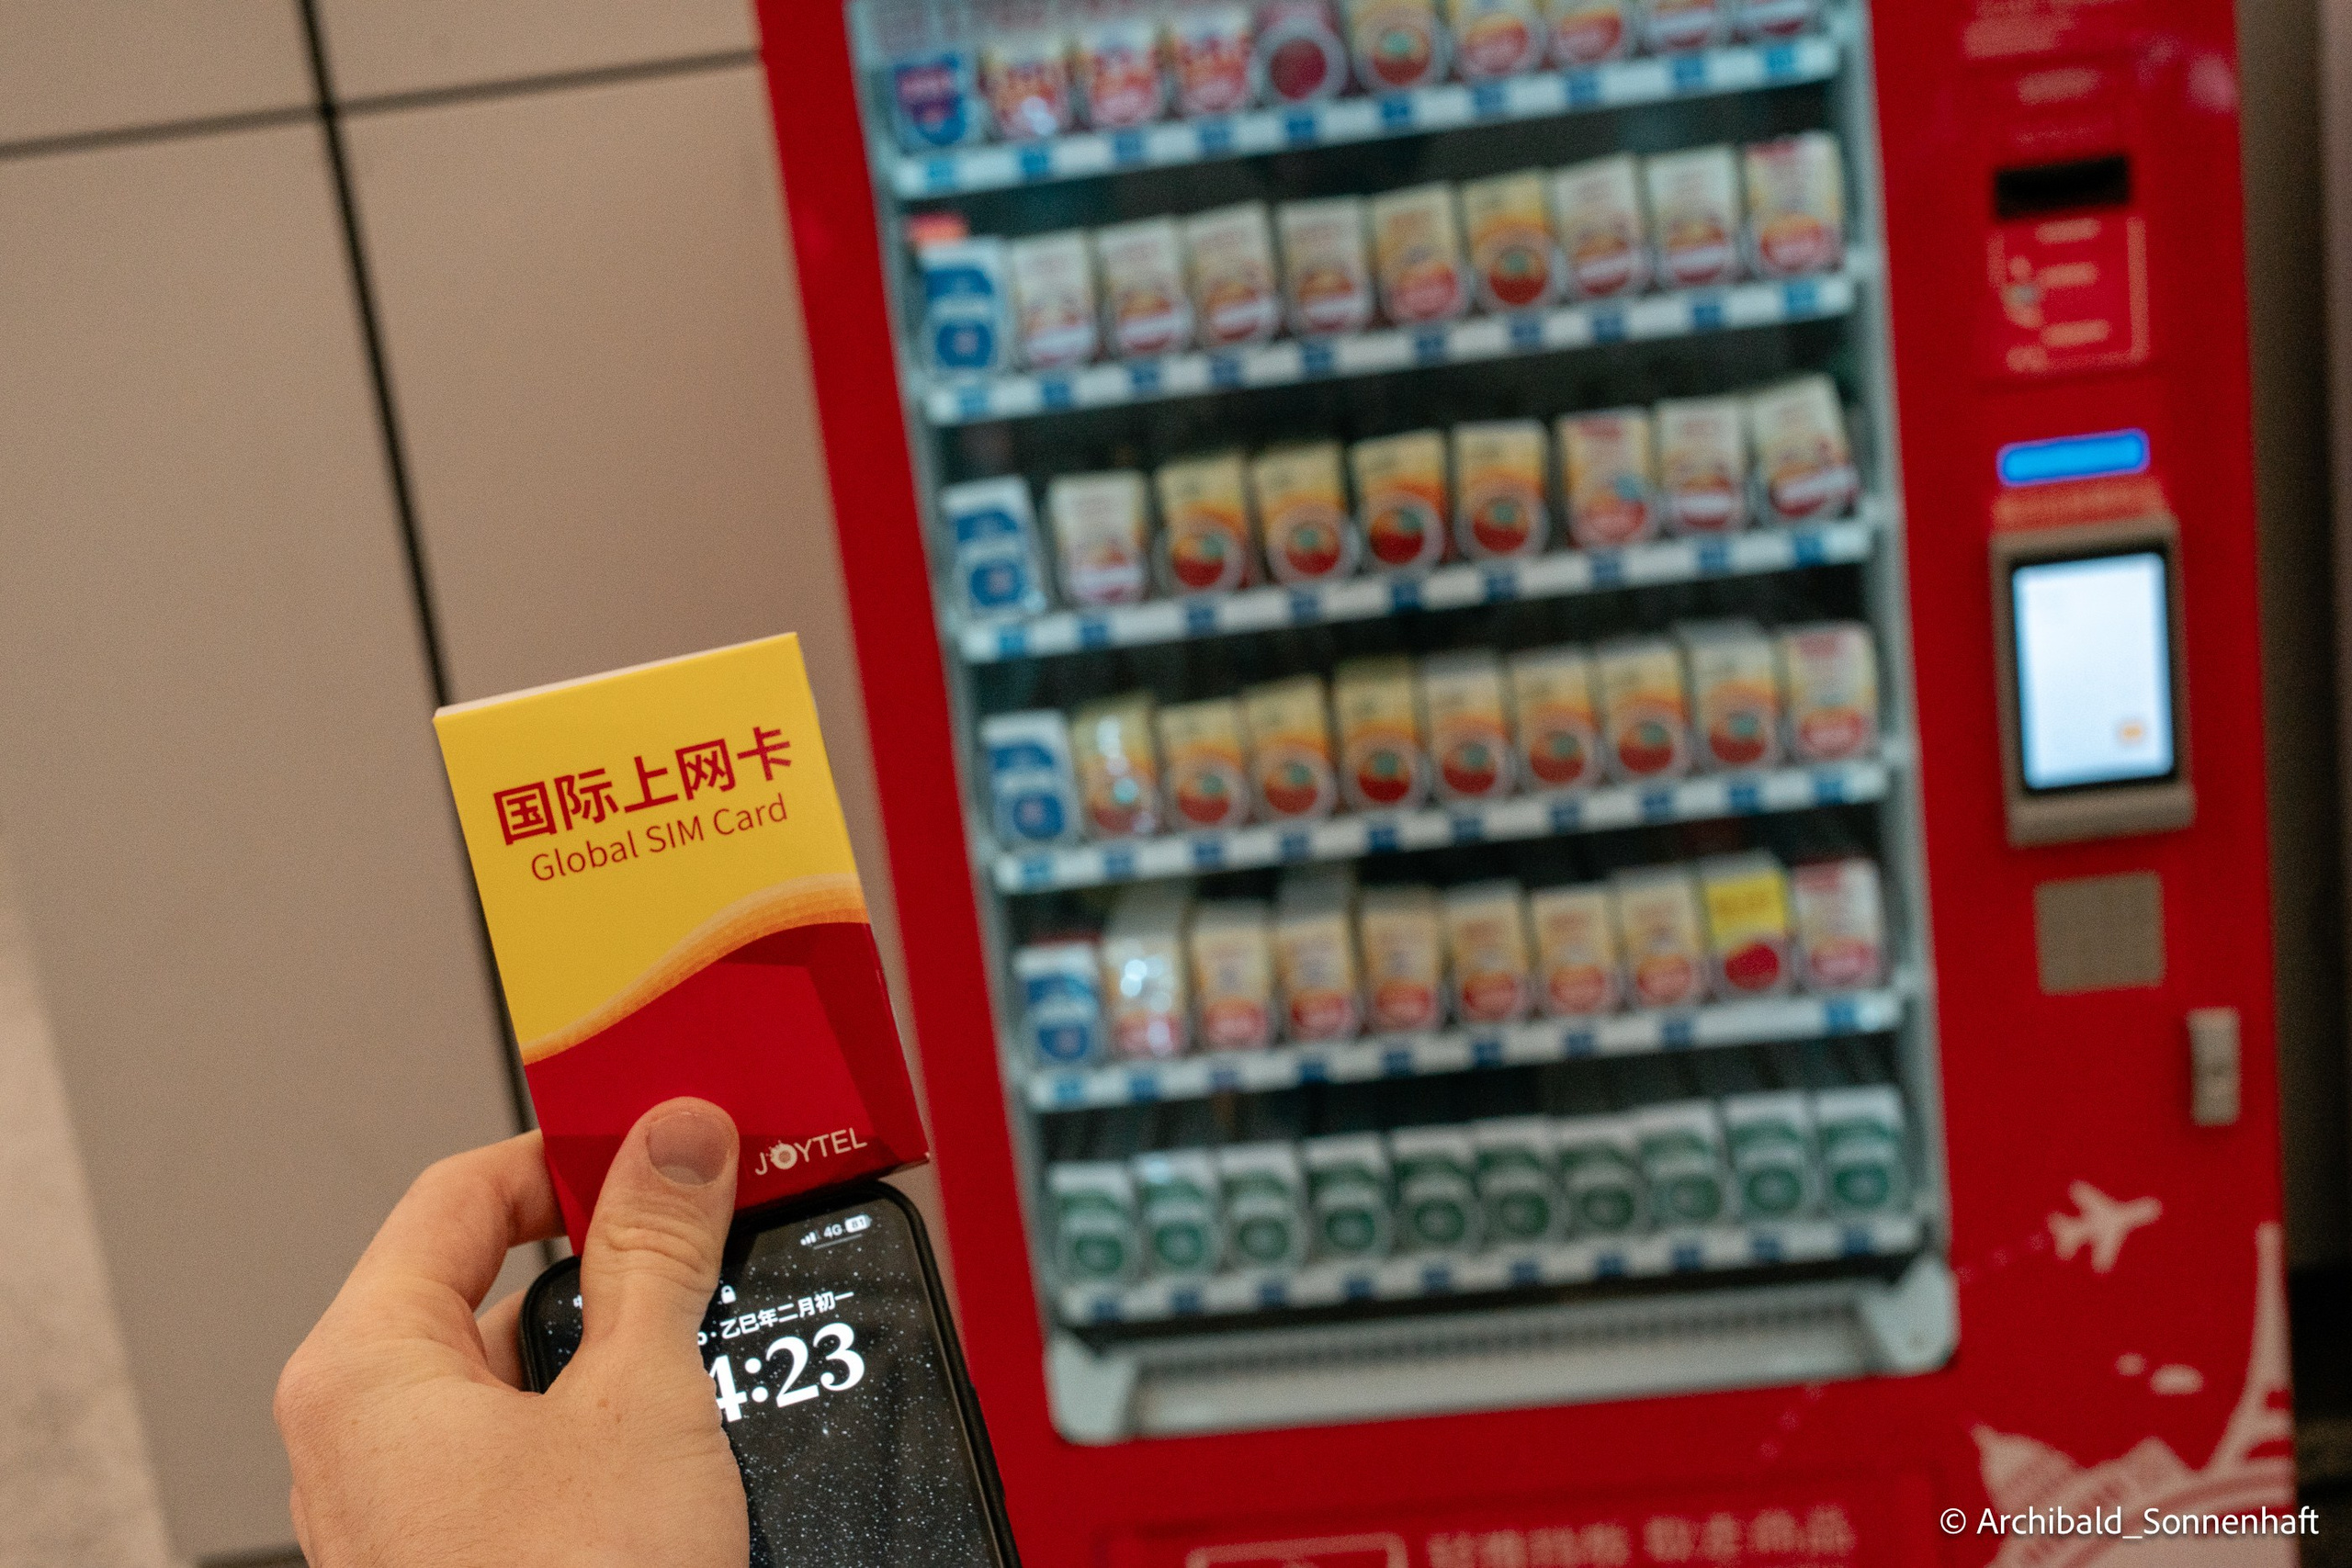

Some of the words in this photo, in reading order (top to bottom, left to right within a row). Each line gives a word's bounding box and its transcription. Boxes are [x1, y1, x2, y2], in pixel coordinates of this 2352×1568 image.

[492, 727, 792, 845] 国际上网卡
[531, 830, 639, 882] Global
[646, 815, 705, 853] SIM
[713, 793, 788, 837] Card
[755, 1127, 867, 1175] JOYTEL
[823, 1224, 842, 1238] 4G
[719, 1291, 854, 1339] 乙巳年二月初一
[708, 1322, 865, 1423] 4:23
